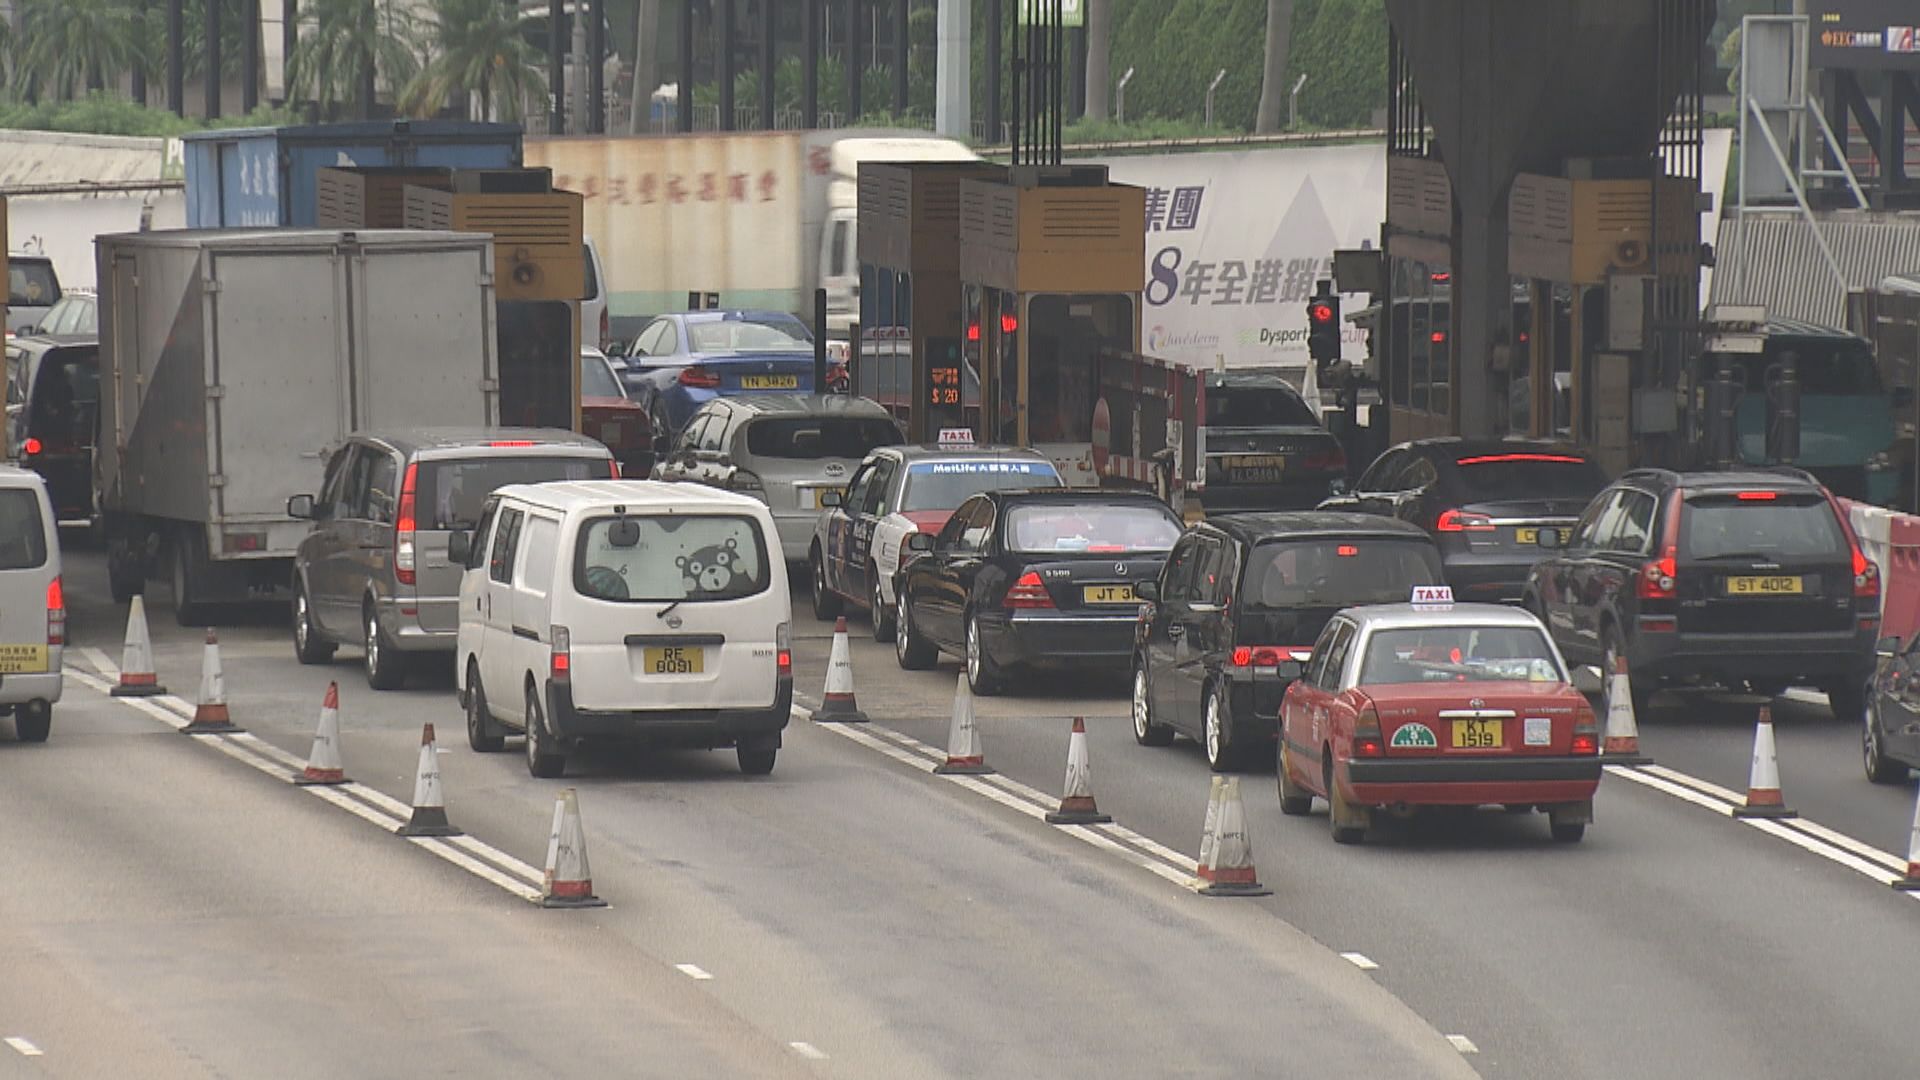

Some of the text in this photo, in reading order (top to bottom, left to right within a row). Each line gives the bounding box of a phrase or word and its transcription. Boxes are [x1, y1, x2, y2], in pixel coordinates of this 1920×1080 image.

[1260, 327, 1309, 345] Dysport
[944, 388, 959, 404] 20
[943, 432, 970, 440] TAXI
[933, 464, 977, 473] MetLife
[1737, 578, 1793, 591] ST 4012
[1097, 588, 1114, 600] JT
[1417, 590, 1449, 599] TAXI
[1467, 720, 1487, 732] KT
[1461, 733, 1493, 745] 1519
